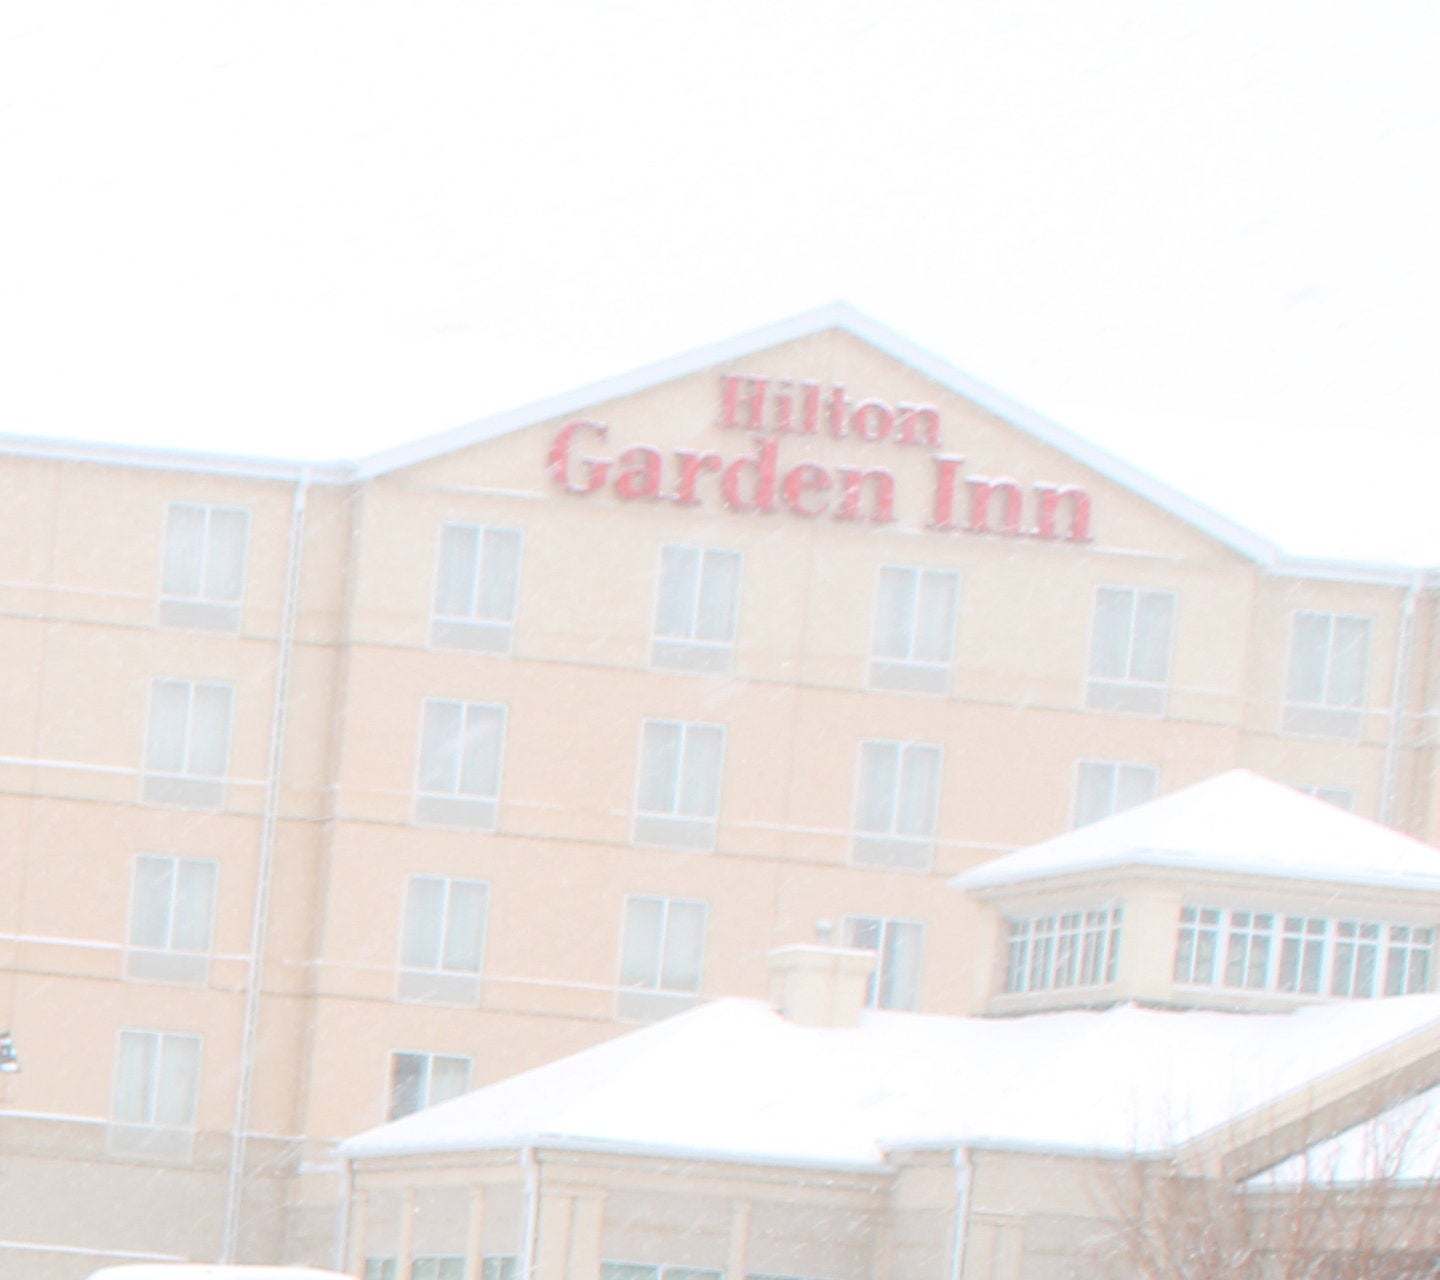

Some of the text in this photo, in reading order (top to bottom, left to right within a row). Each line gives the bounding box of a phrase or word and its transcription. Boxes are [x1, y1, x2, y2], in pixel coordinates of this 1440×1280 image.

[717, 374, 943, 449] Hilton
[547, 418, 1095, 544] Garden Inn
